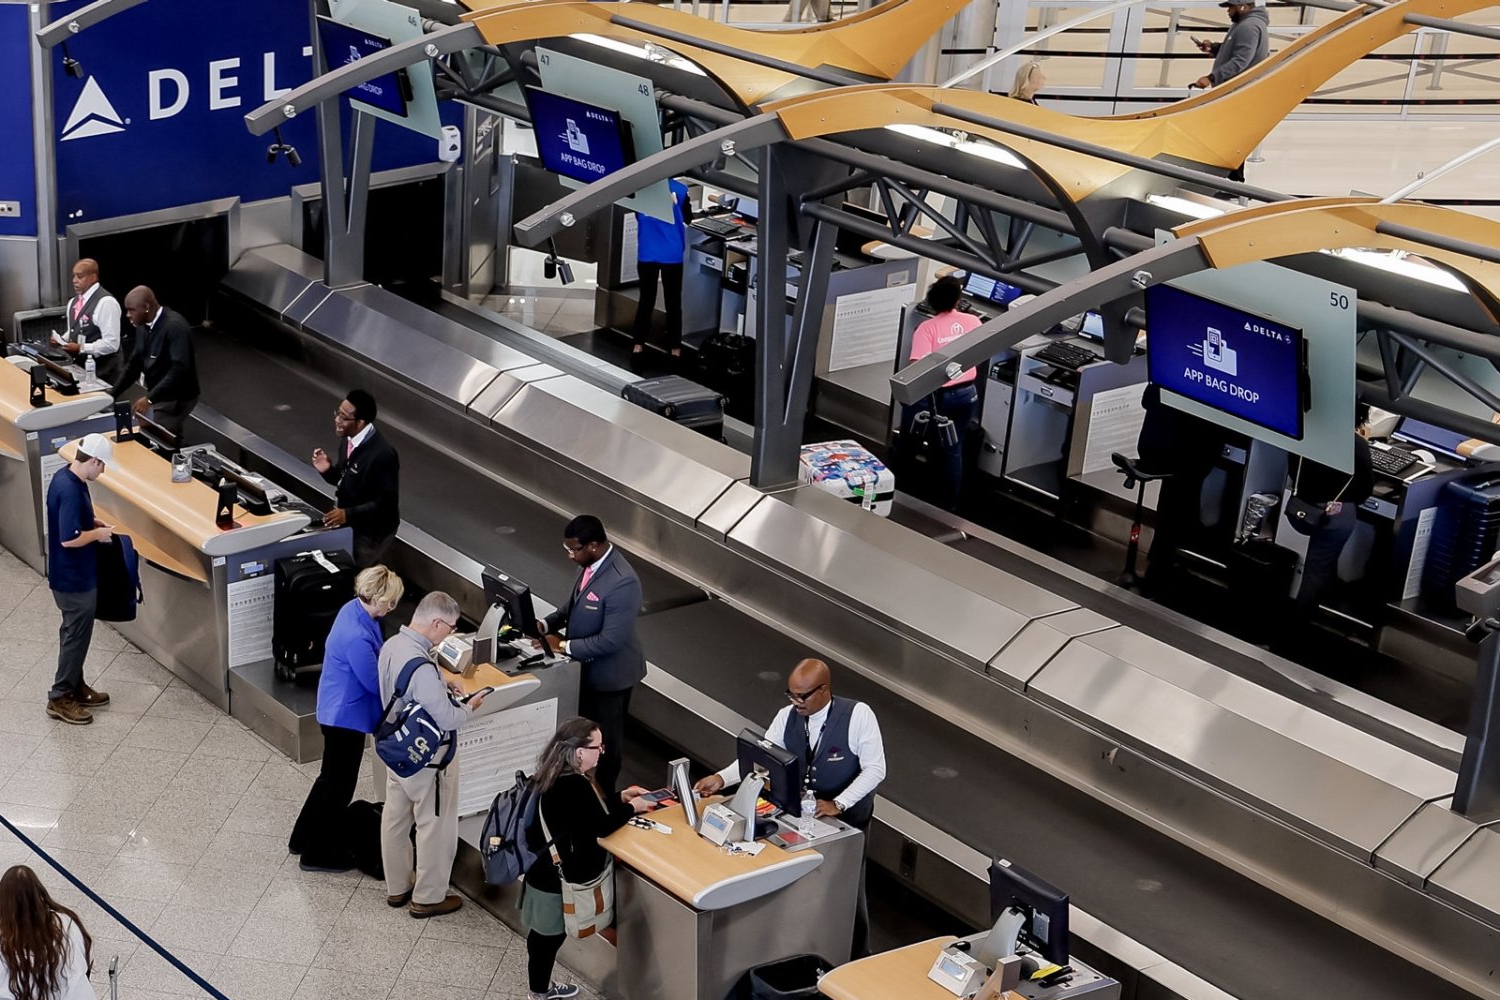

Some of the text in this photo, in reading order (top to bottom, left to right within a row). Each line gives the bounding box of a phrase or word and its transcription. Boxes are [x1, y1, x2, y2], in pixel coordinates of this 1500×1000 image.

[408, 15, 418, 27] 46
[540, 54, 650, 97] 47 48
[591, 112, 609, 122] DELTA
[560, 152, 606, 174] APP BAG DROP
[1329, 291, 1349, 310] 50
[1253, 324, 1283, 342] DELTA
[1184, 367, 1260, 404] APP BAG DROP
